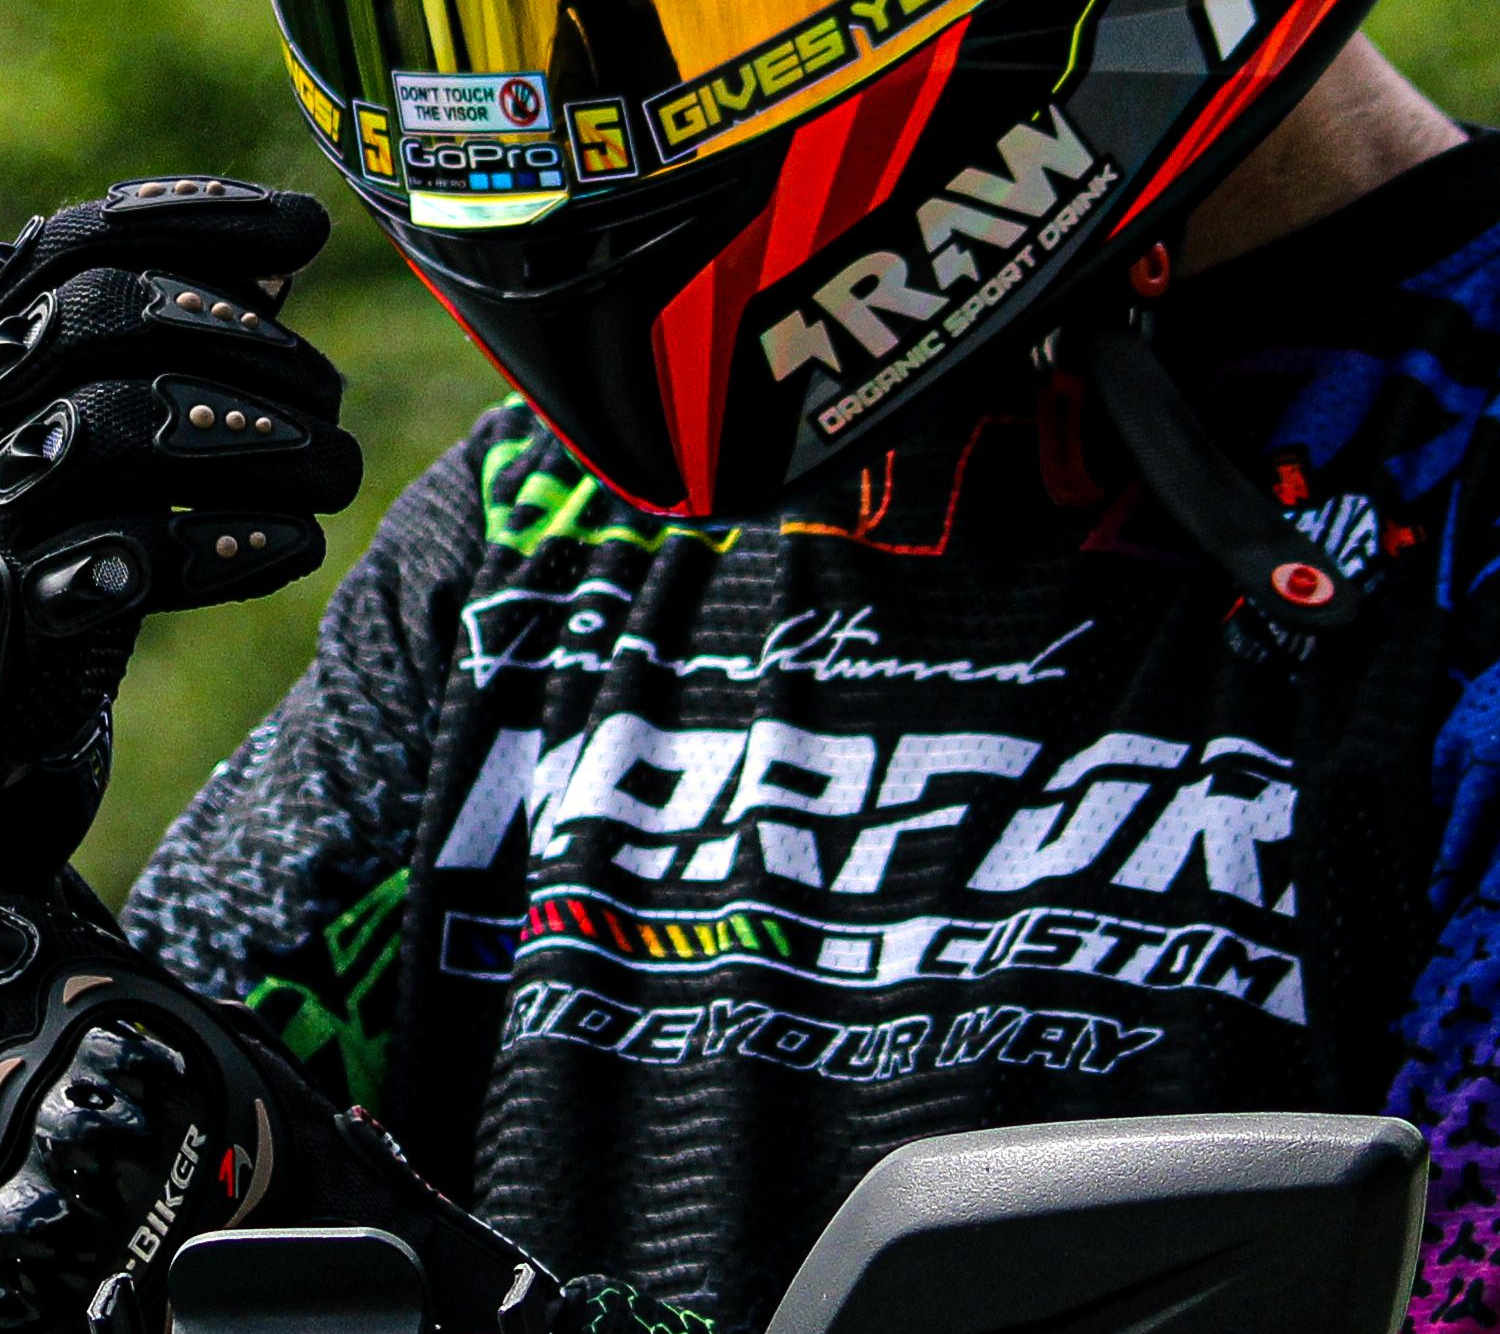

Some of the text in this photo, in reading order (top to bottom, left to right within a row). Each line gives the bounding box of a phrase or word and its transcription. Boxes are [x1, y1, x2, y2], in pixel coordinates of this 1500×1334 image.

[400, 86, 495, 102] DON'T TOUCH
[413, 105, 489, 122] THE VISOR
[657, 20, 847, 147] GIVES
[405, 142, 559, 170] GoPro
[573, 106, 630, 173] 5
[817, 163, 1119, 435] ORGANIC SPORT DRINK
[501, 979, 706, 1064] RIDE
[936, 1005, 1165, 1074] WAY
